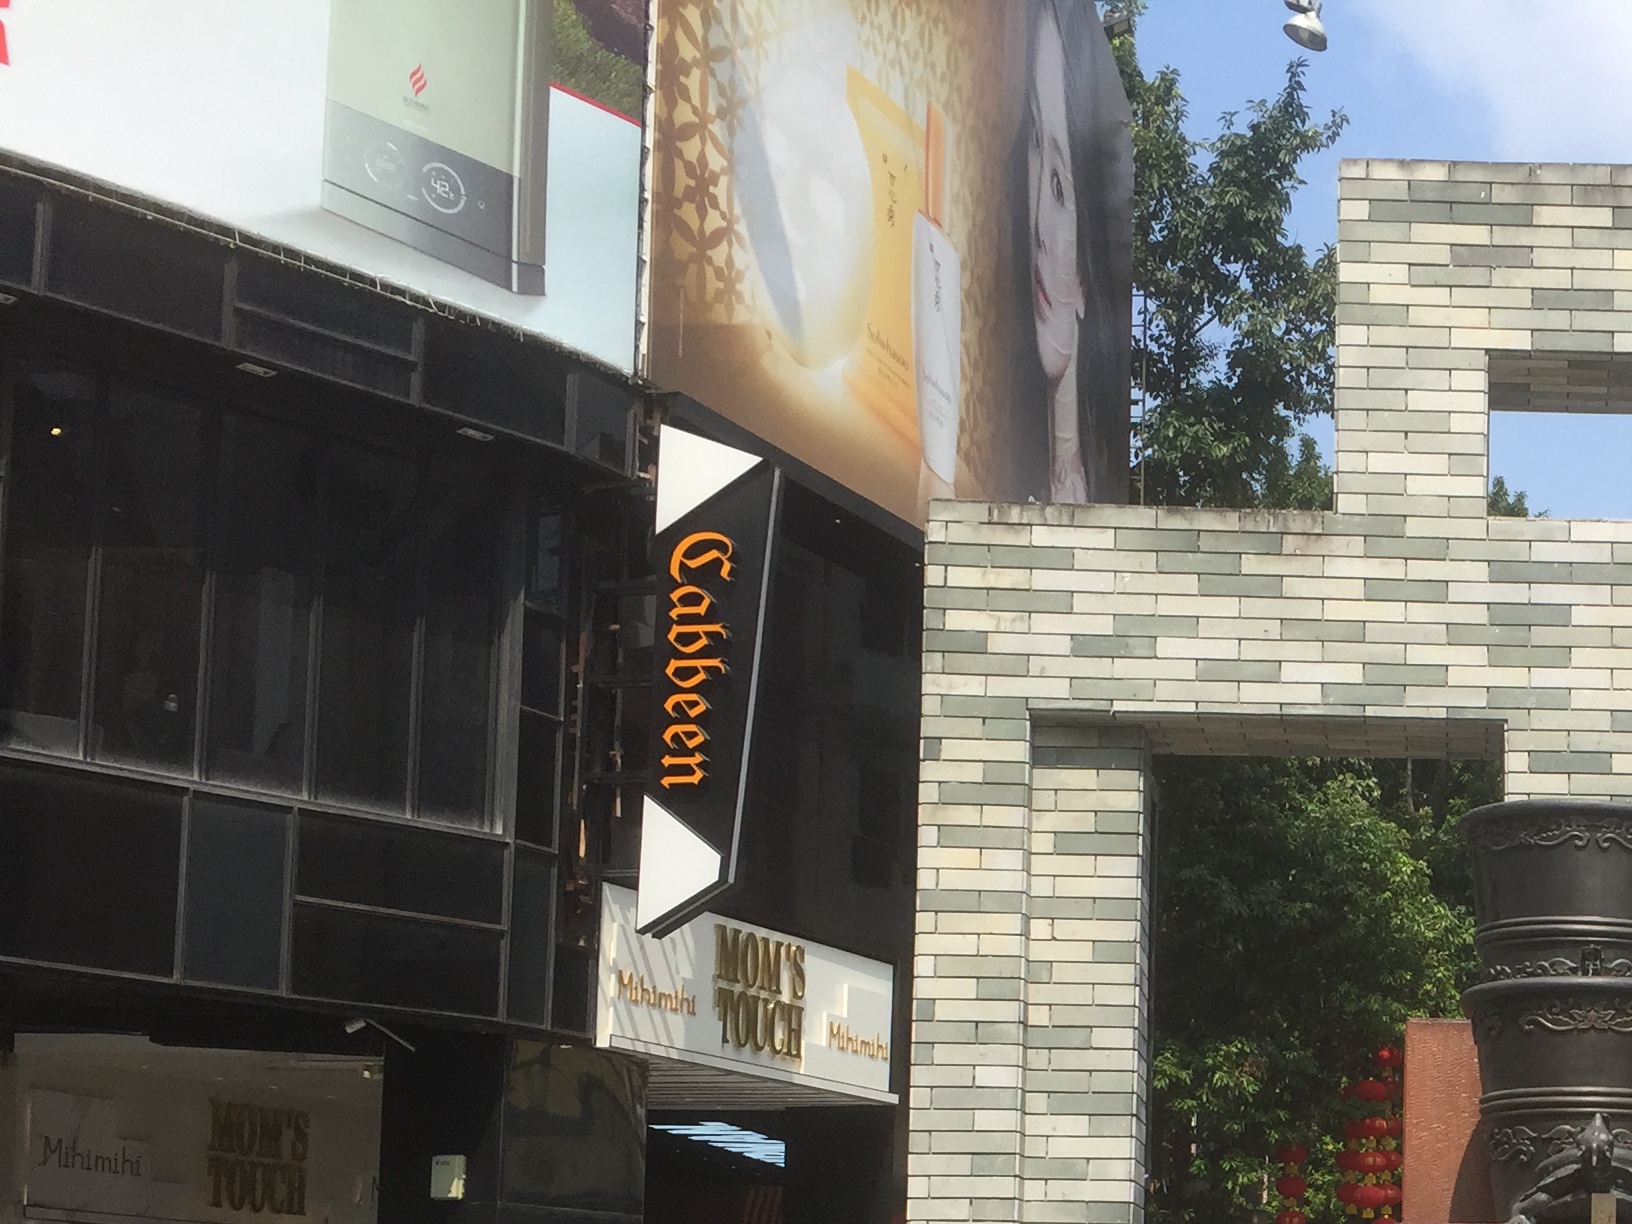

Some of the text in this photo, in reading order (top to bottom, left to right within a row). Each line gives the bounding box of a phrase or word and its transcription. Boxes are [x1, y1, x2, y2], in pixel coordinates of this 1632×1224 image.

[660, 531, 733, 789] Cabbeen
[713, 923, 806, 1000] MOM'S
[618, 969, 697, 1017] Mihimihi
[713, 986, 805, 1060] TOUCH
[828, 1021, 889, 1061] Mihimihi
[39, 1135, 142, 1177] Mihimihi
[208, 1100, 310, 1162] MOM'S
[207, 1155, 307, 1216] TOUCH
